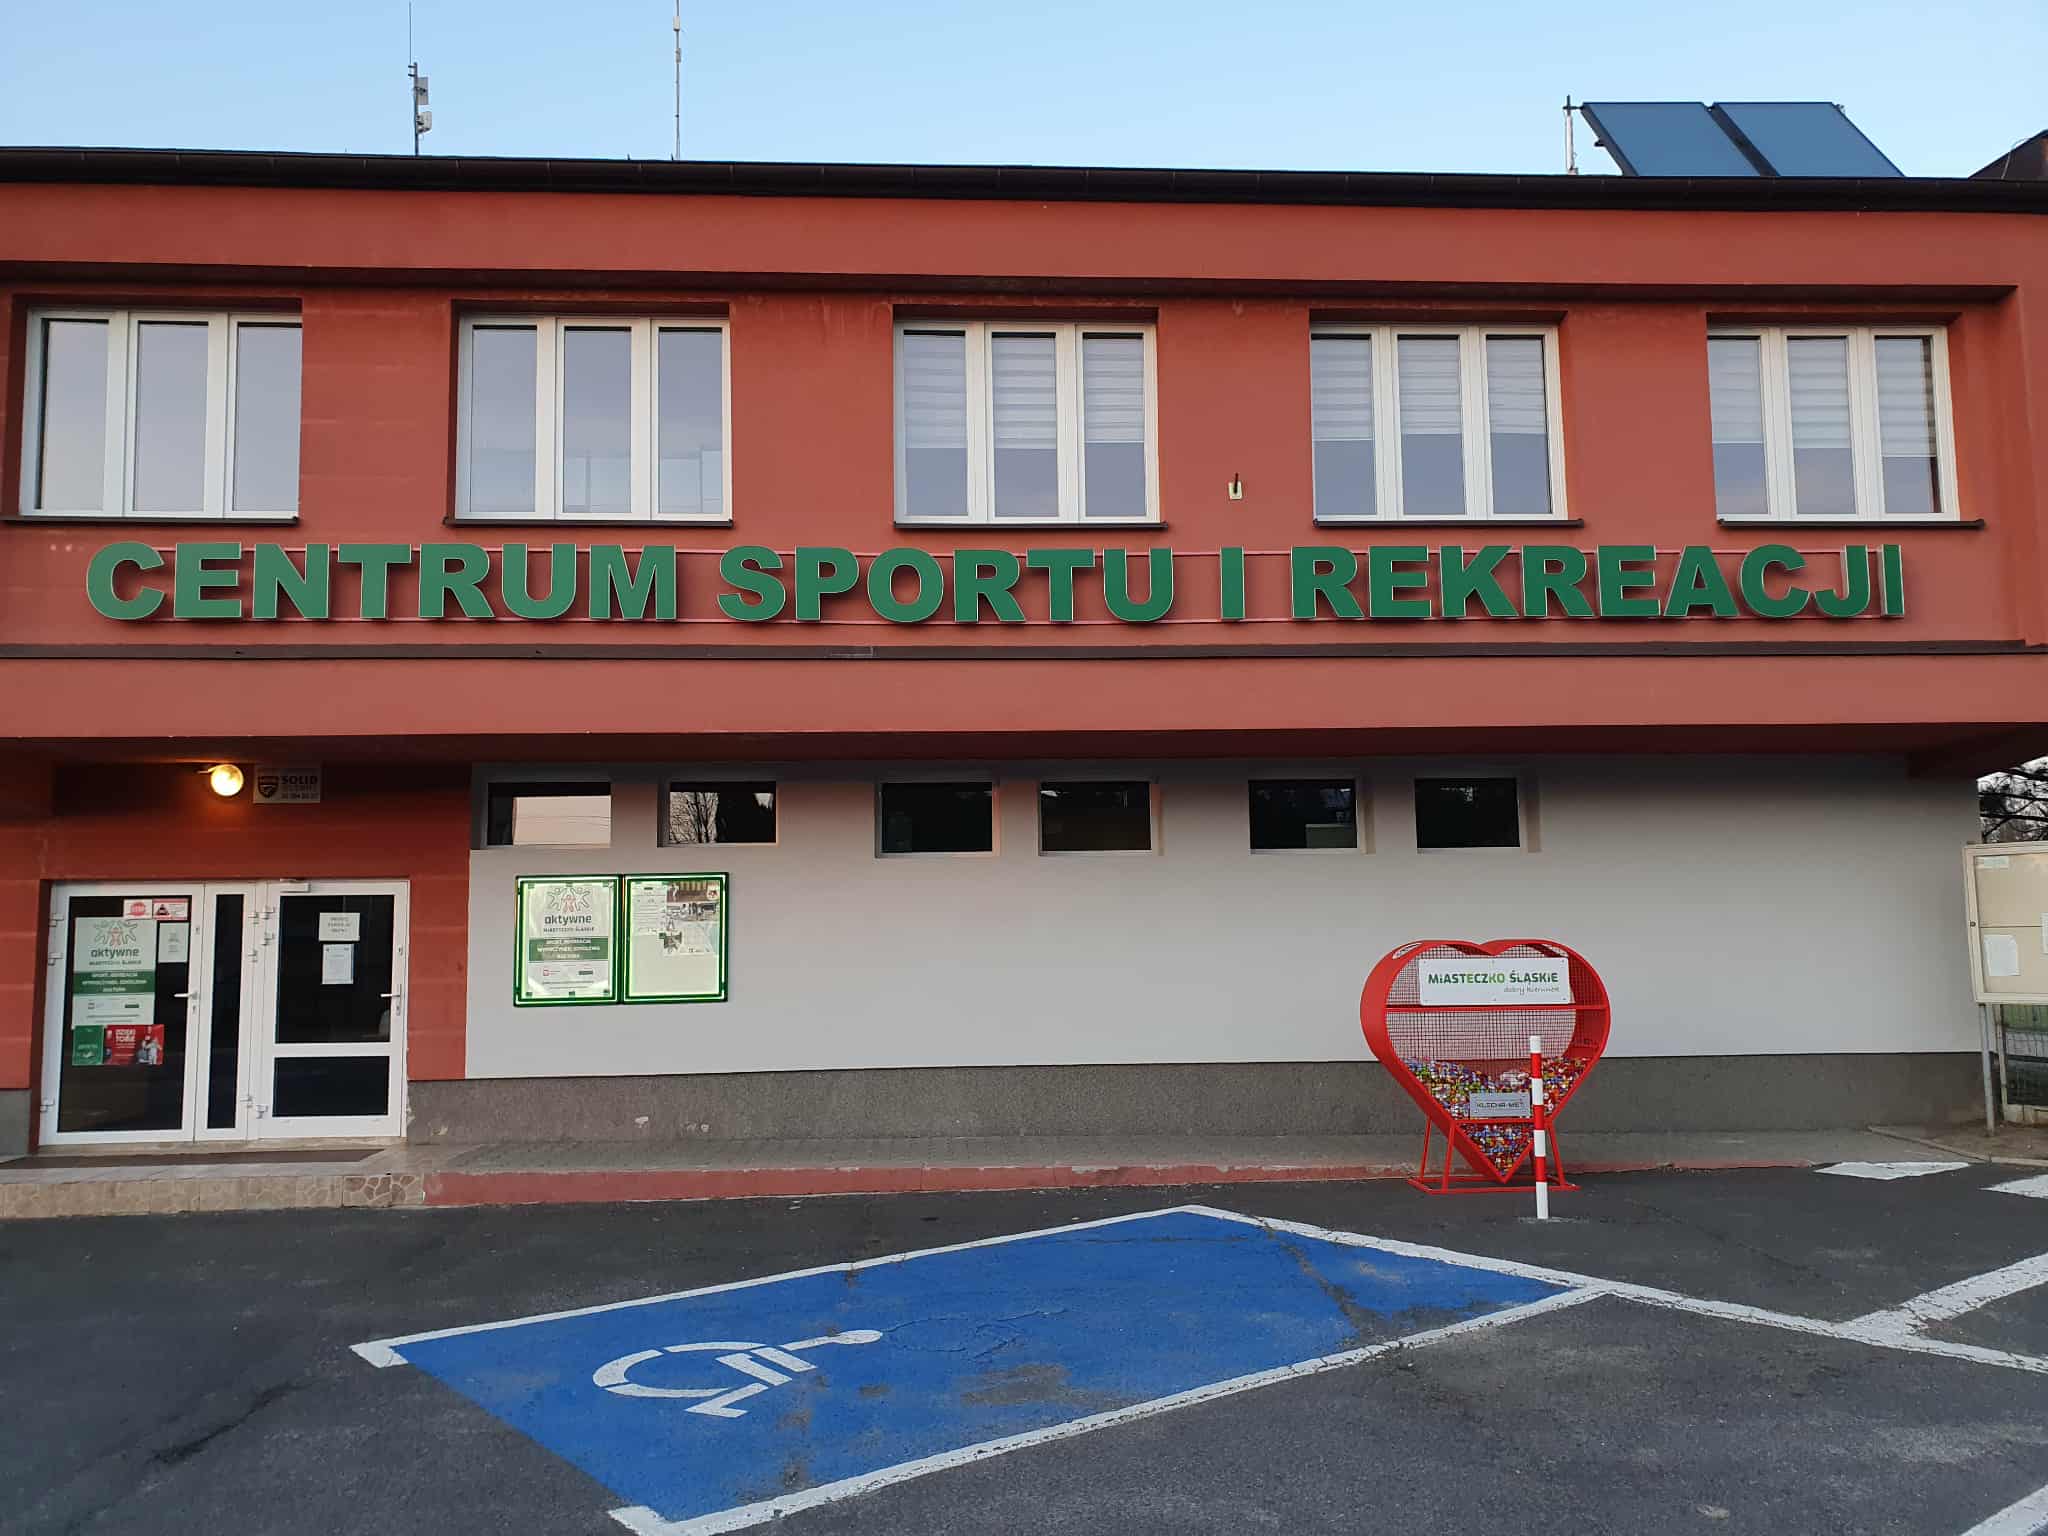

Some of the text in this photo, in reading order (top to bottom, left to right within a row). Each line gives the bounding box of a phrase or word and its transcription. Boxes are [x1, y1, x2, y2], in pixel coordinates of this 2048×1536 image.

[86, 541, 1905, 622] CENTRUM SPORTU I REKREACJI
[280, 775, 318, 785] SOLID
[544, 915, 592, 926] aktywne
[90, 947, 140, 959] aktywne
